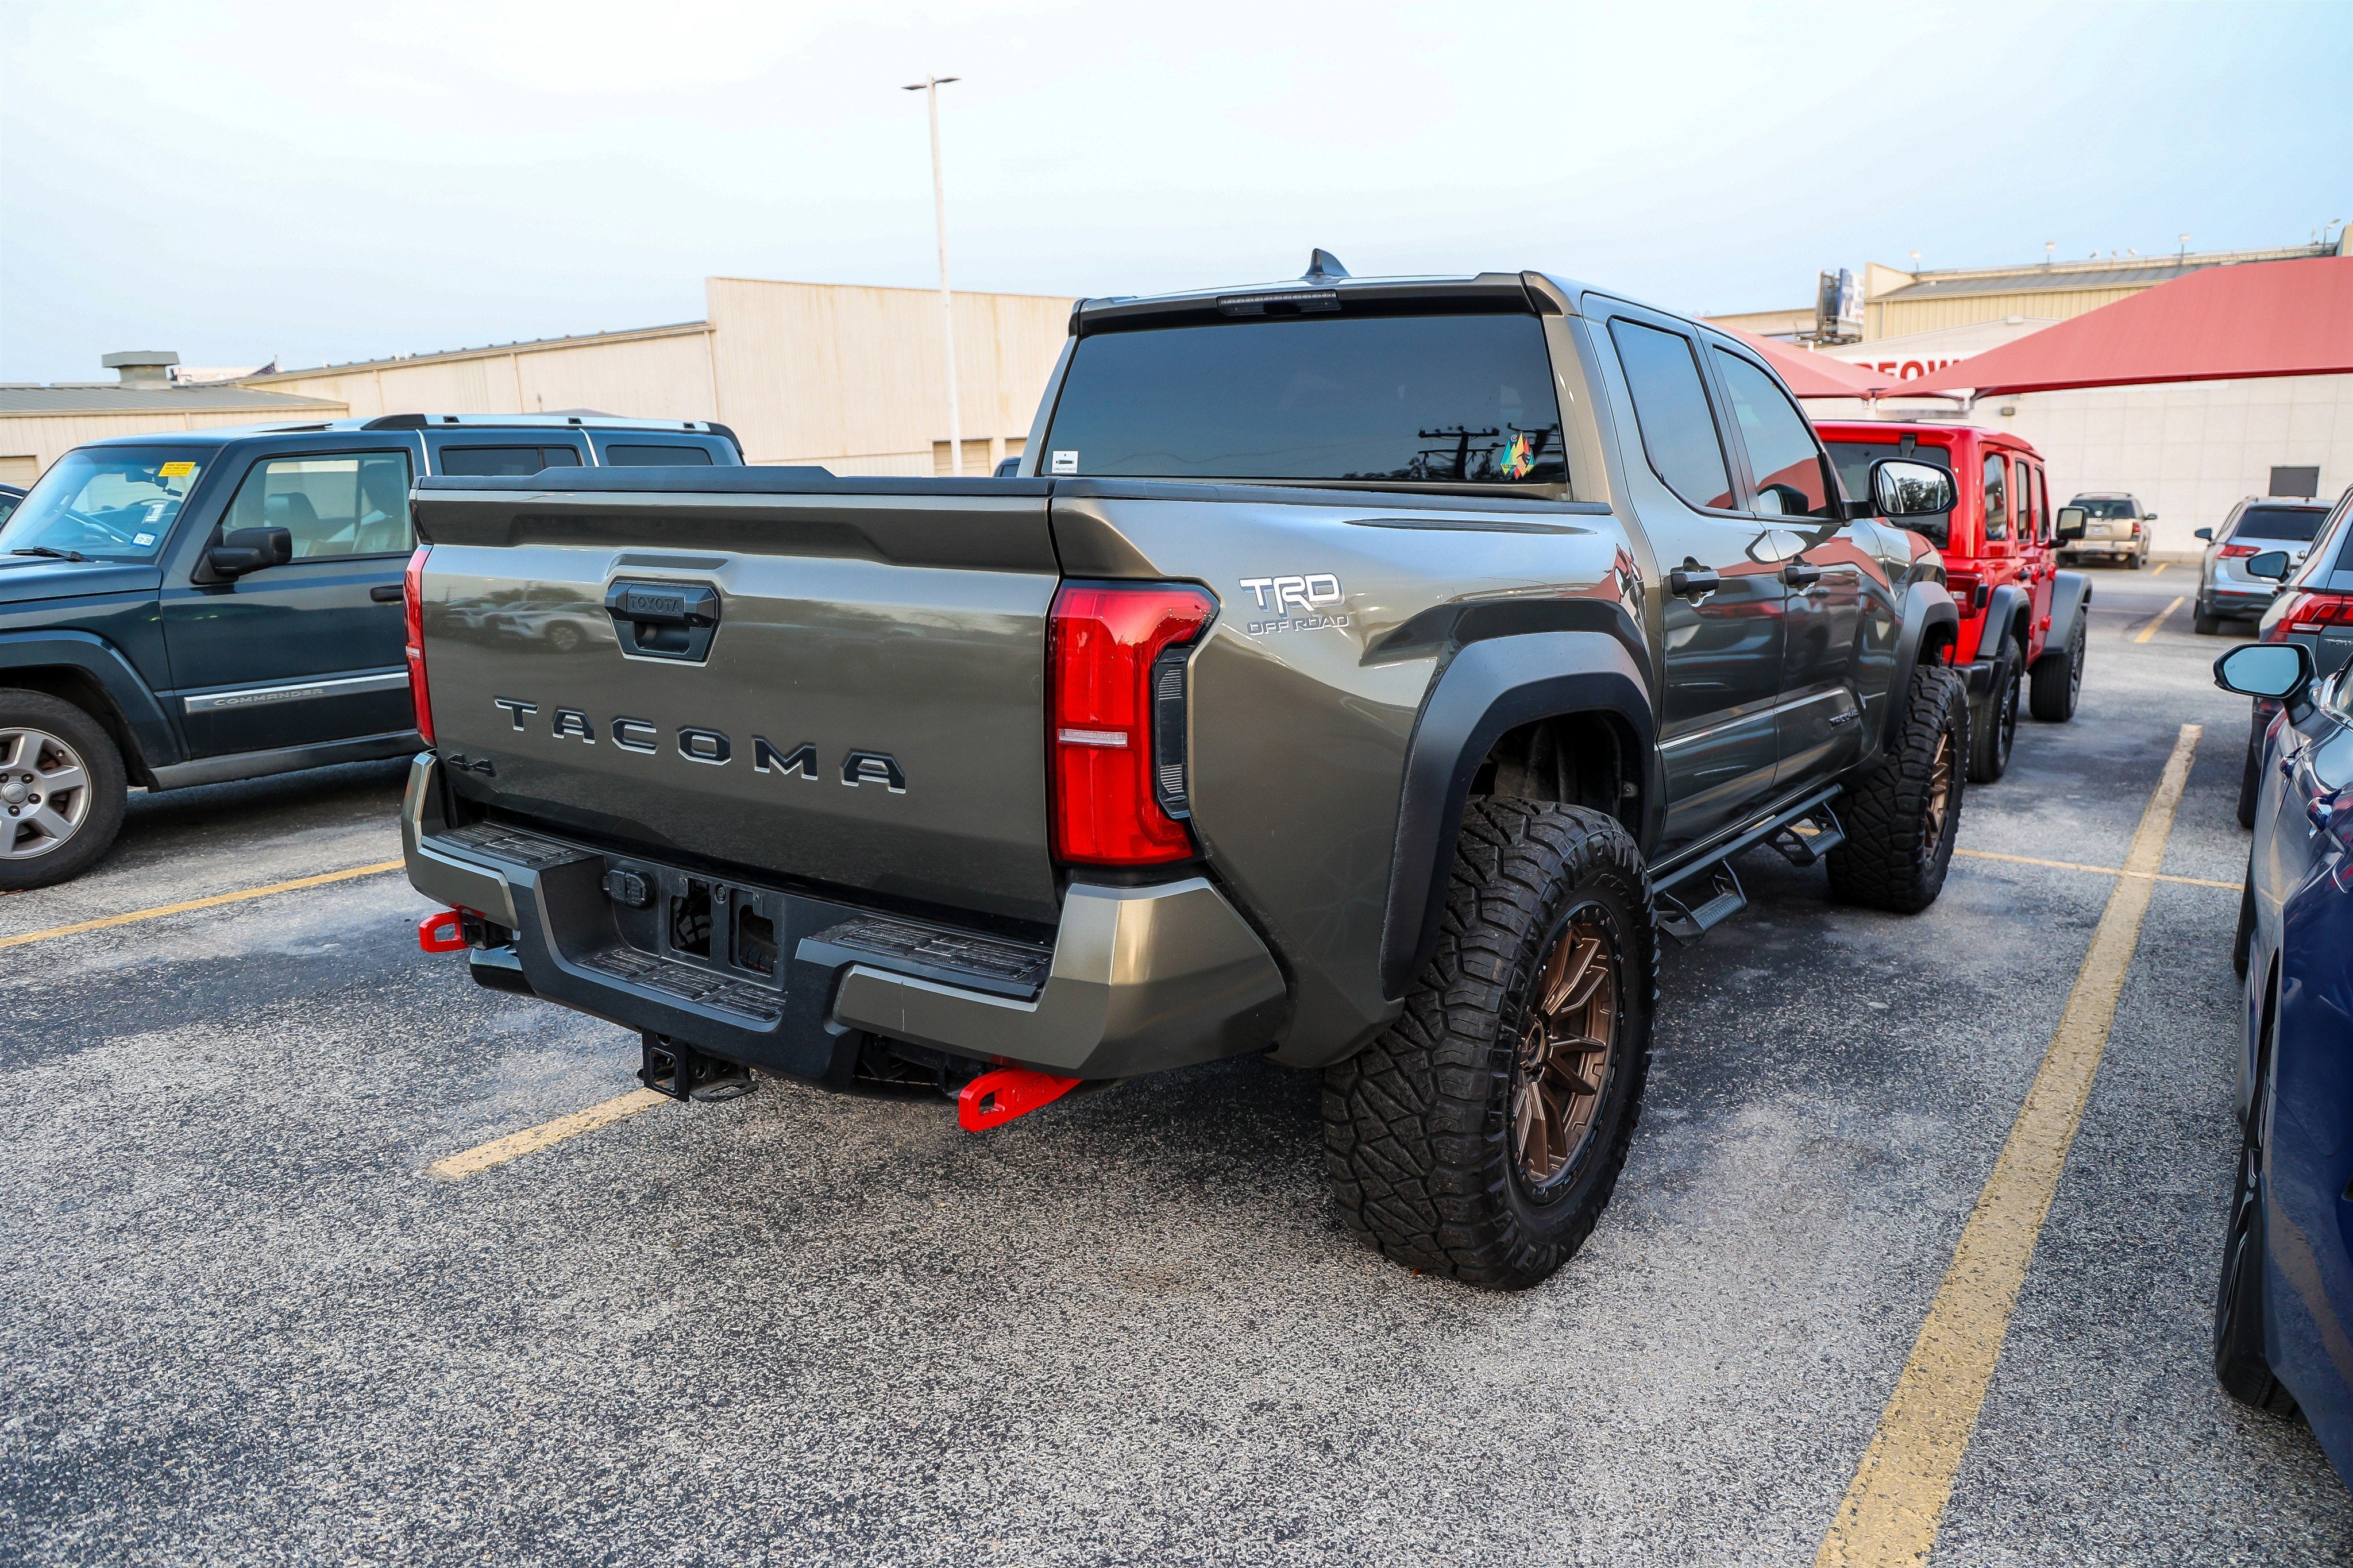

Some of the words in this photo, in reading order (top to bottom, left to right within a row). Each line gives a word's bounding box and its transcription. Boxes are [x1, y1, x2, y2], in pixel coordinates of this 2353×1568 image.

[630, 596, 681, 614] TOYOTA
[1239, 573, 1345, 619] TRD
[1247, 620, 1290, 636] OFF
[1292, 613, 1350, 632] ROAD
[213, 688, 325, 706] COMMANDER
[493, 696, 907, 794] TACOMA
